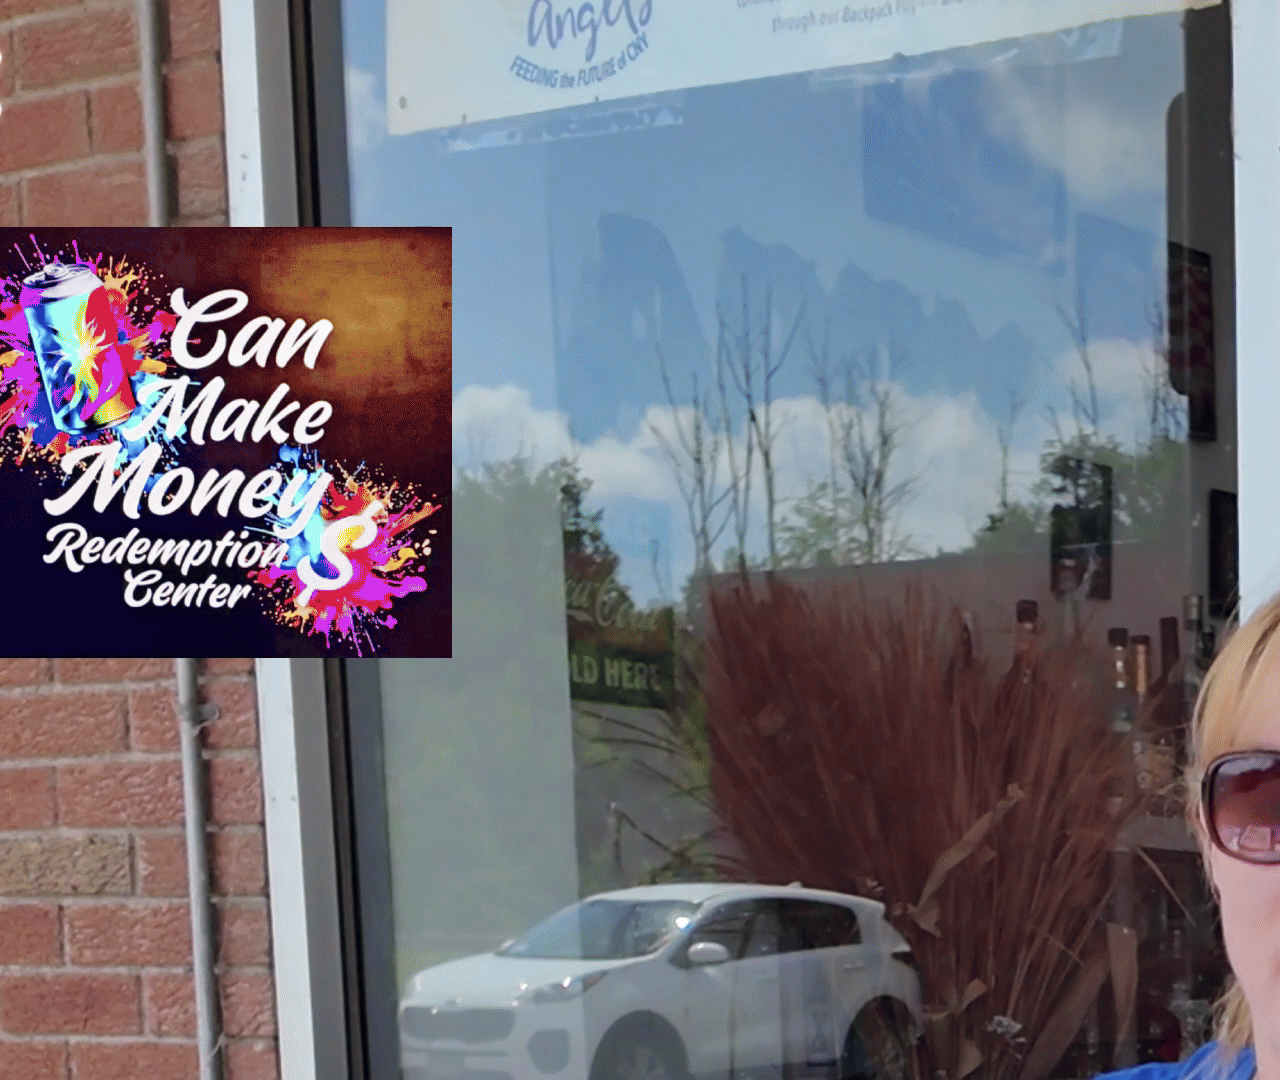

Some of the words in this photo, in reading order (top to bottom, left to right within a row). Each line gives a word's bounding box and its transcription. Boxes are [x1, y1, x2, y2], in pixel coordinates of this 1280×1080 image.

[510, 54, 559, 88] FEEDING
[577, 57, 616, 86] FUTURE
[626, 31, 649, 61] CNY
